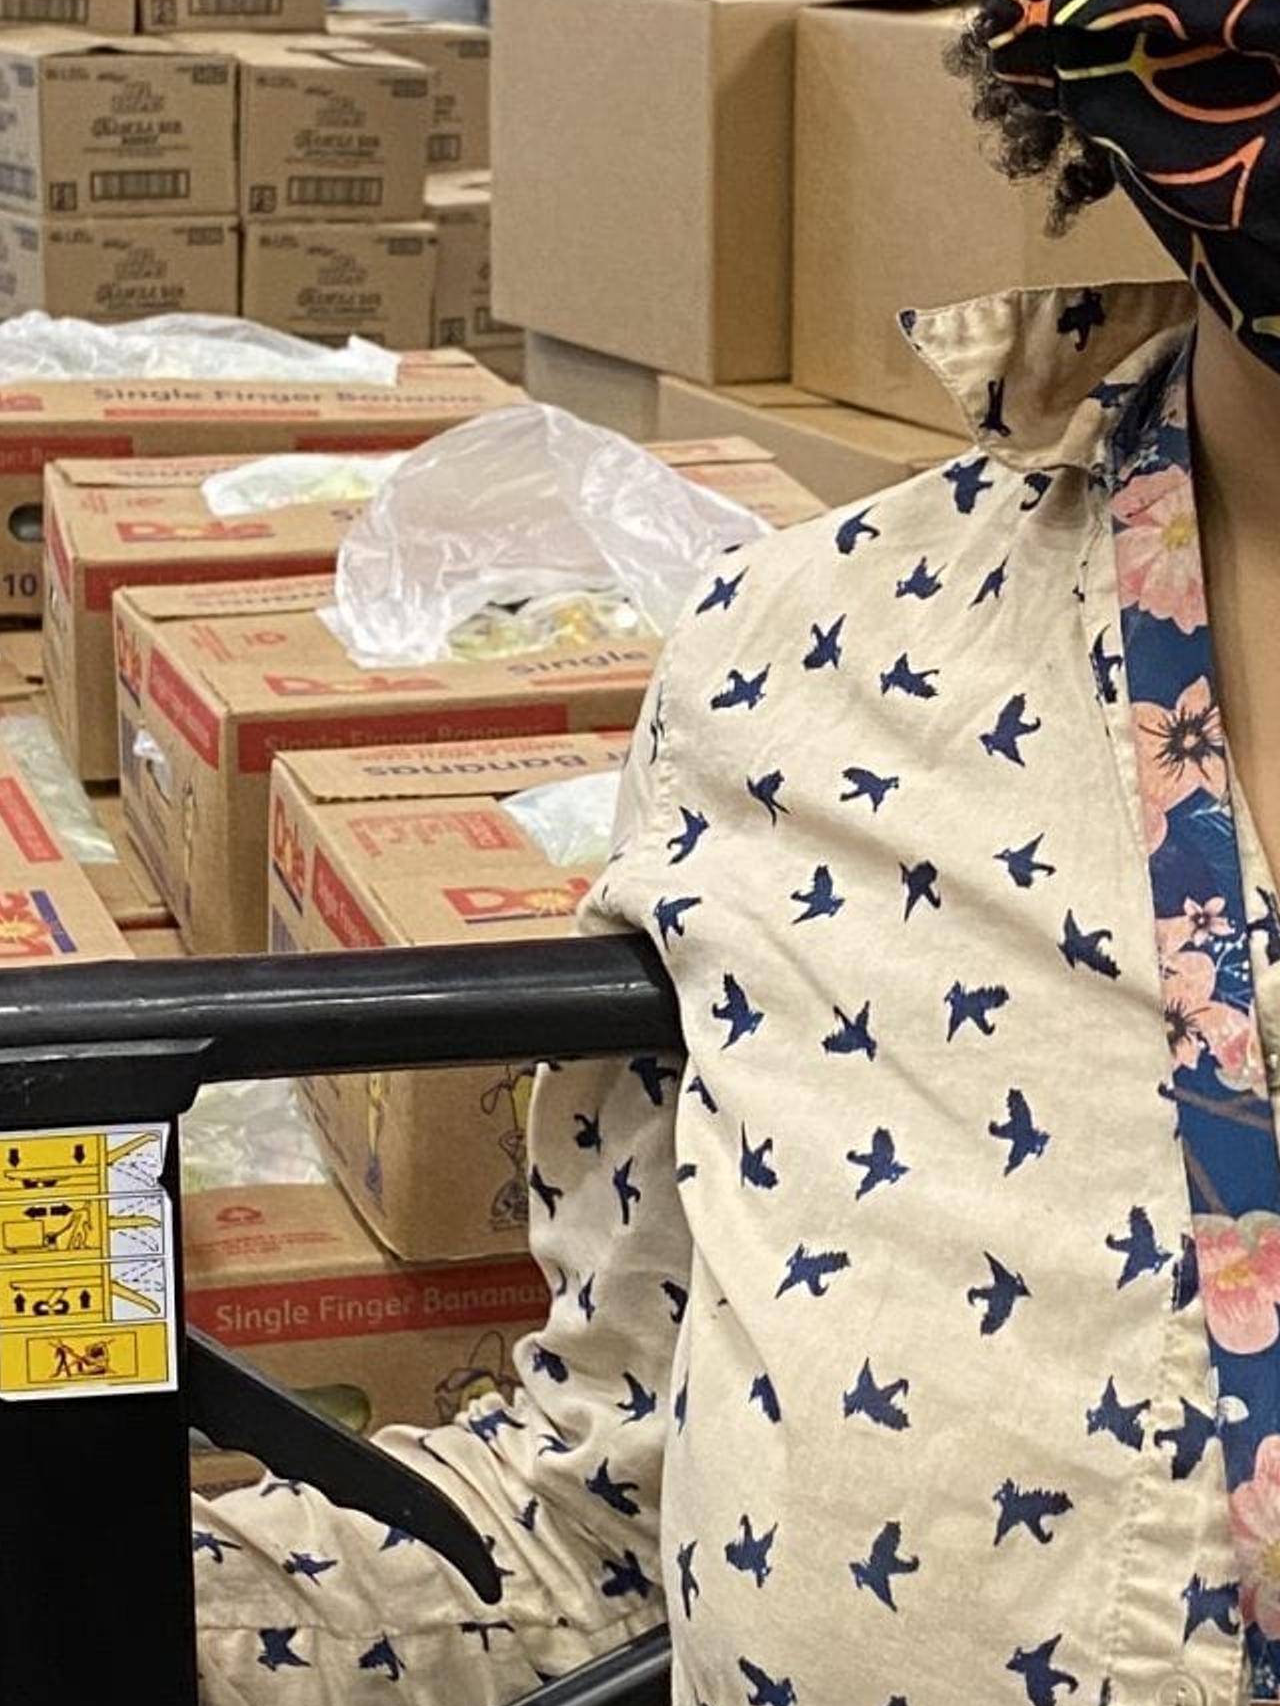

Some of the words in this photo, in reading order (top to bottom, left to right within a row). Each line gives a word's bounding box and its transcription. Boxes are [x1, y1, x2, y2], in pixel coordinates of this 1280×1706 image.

[507, 648, 652, 675] Single
[361, 753, 586, 777] Bananas
[216, 1299, 310, 1333] Single
[320, 1291, 413, 1324] Finger
